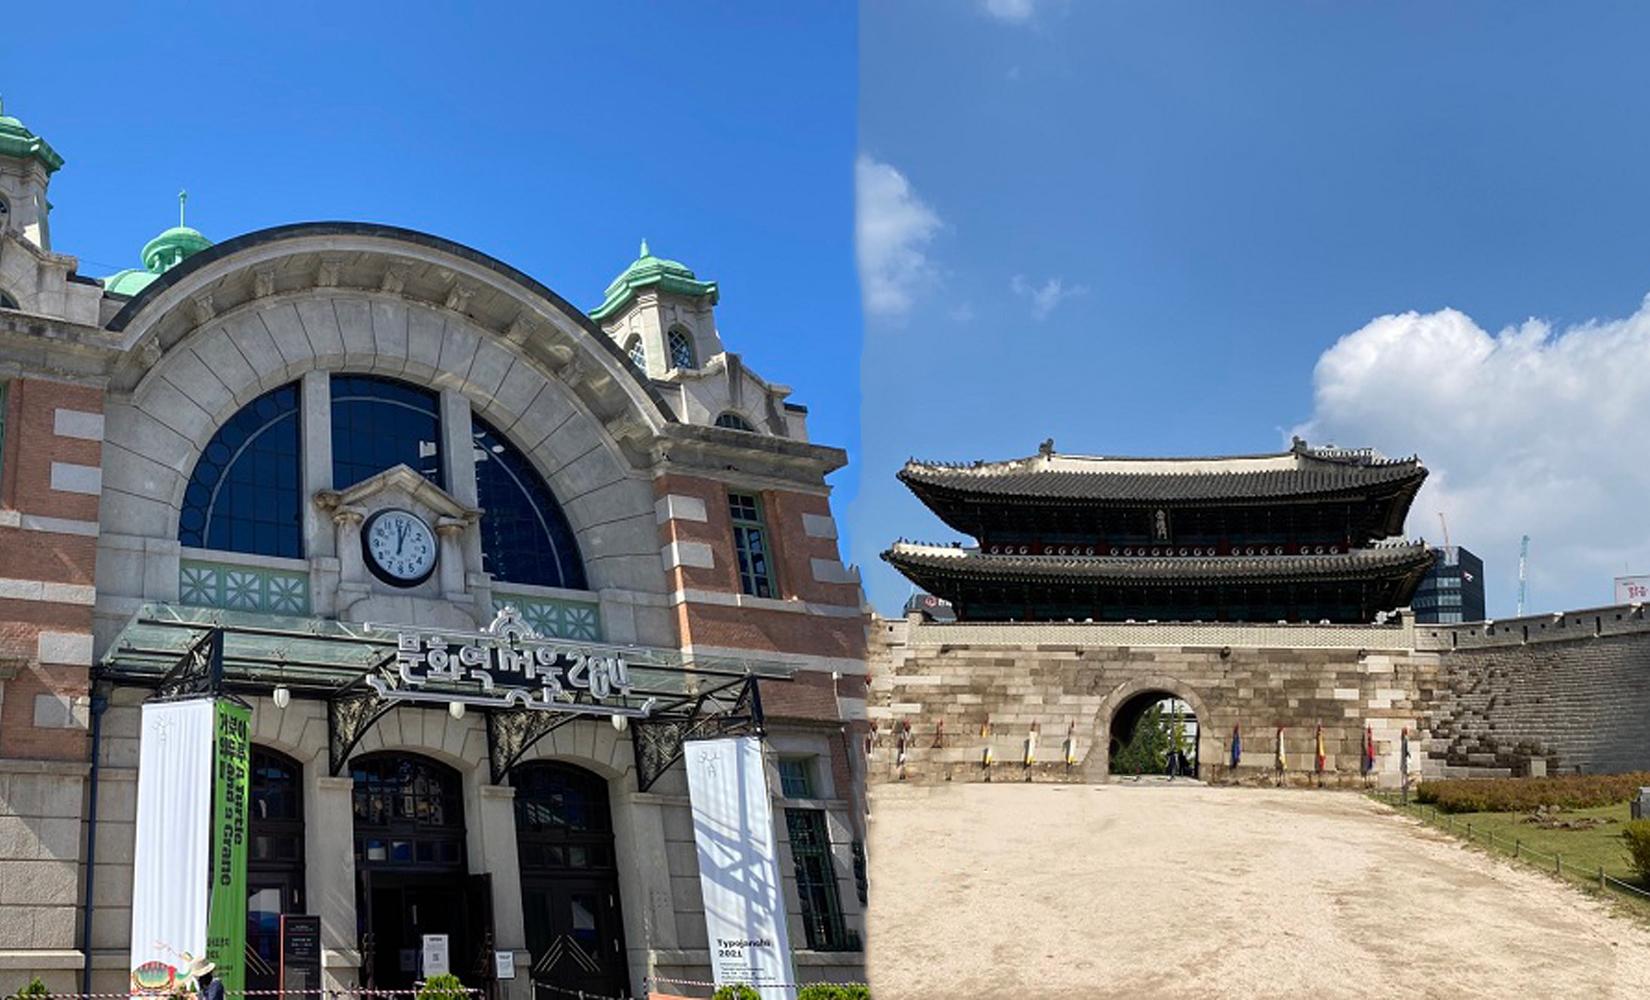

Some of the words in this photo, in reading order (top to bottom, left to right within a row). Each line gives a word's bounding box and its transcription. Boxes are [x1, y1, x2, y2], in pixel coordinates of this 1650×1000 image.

[234, 784, 244, 846] Turtle
[220, 824, 233, 887] Crane
[719, 949, 743, 958] 2021
